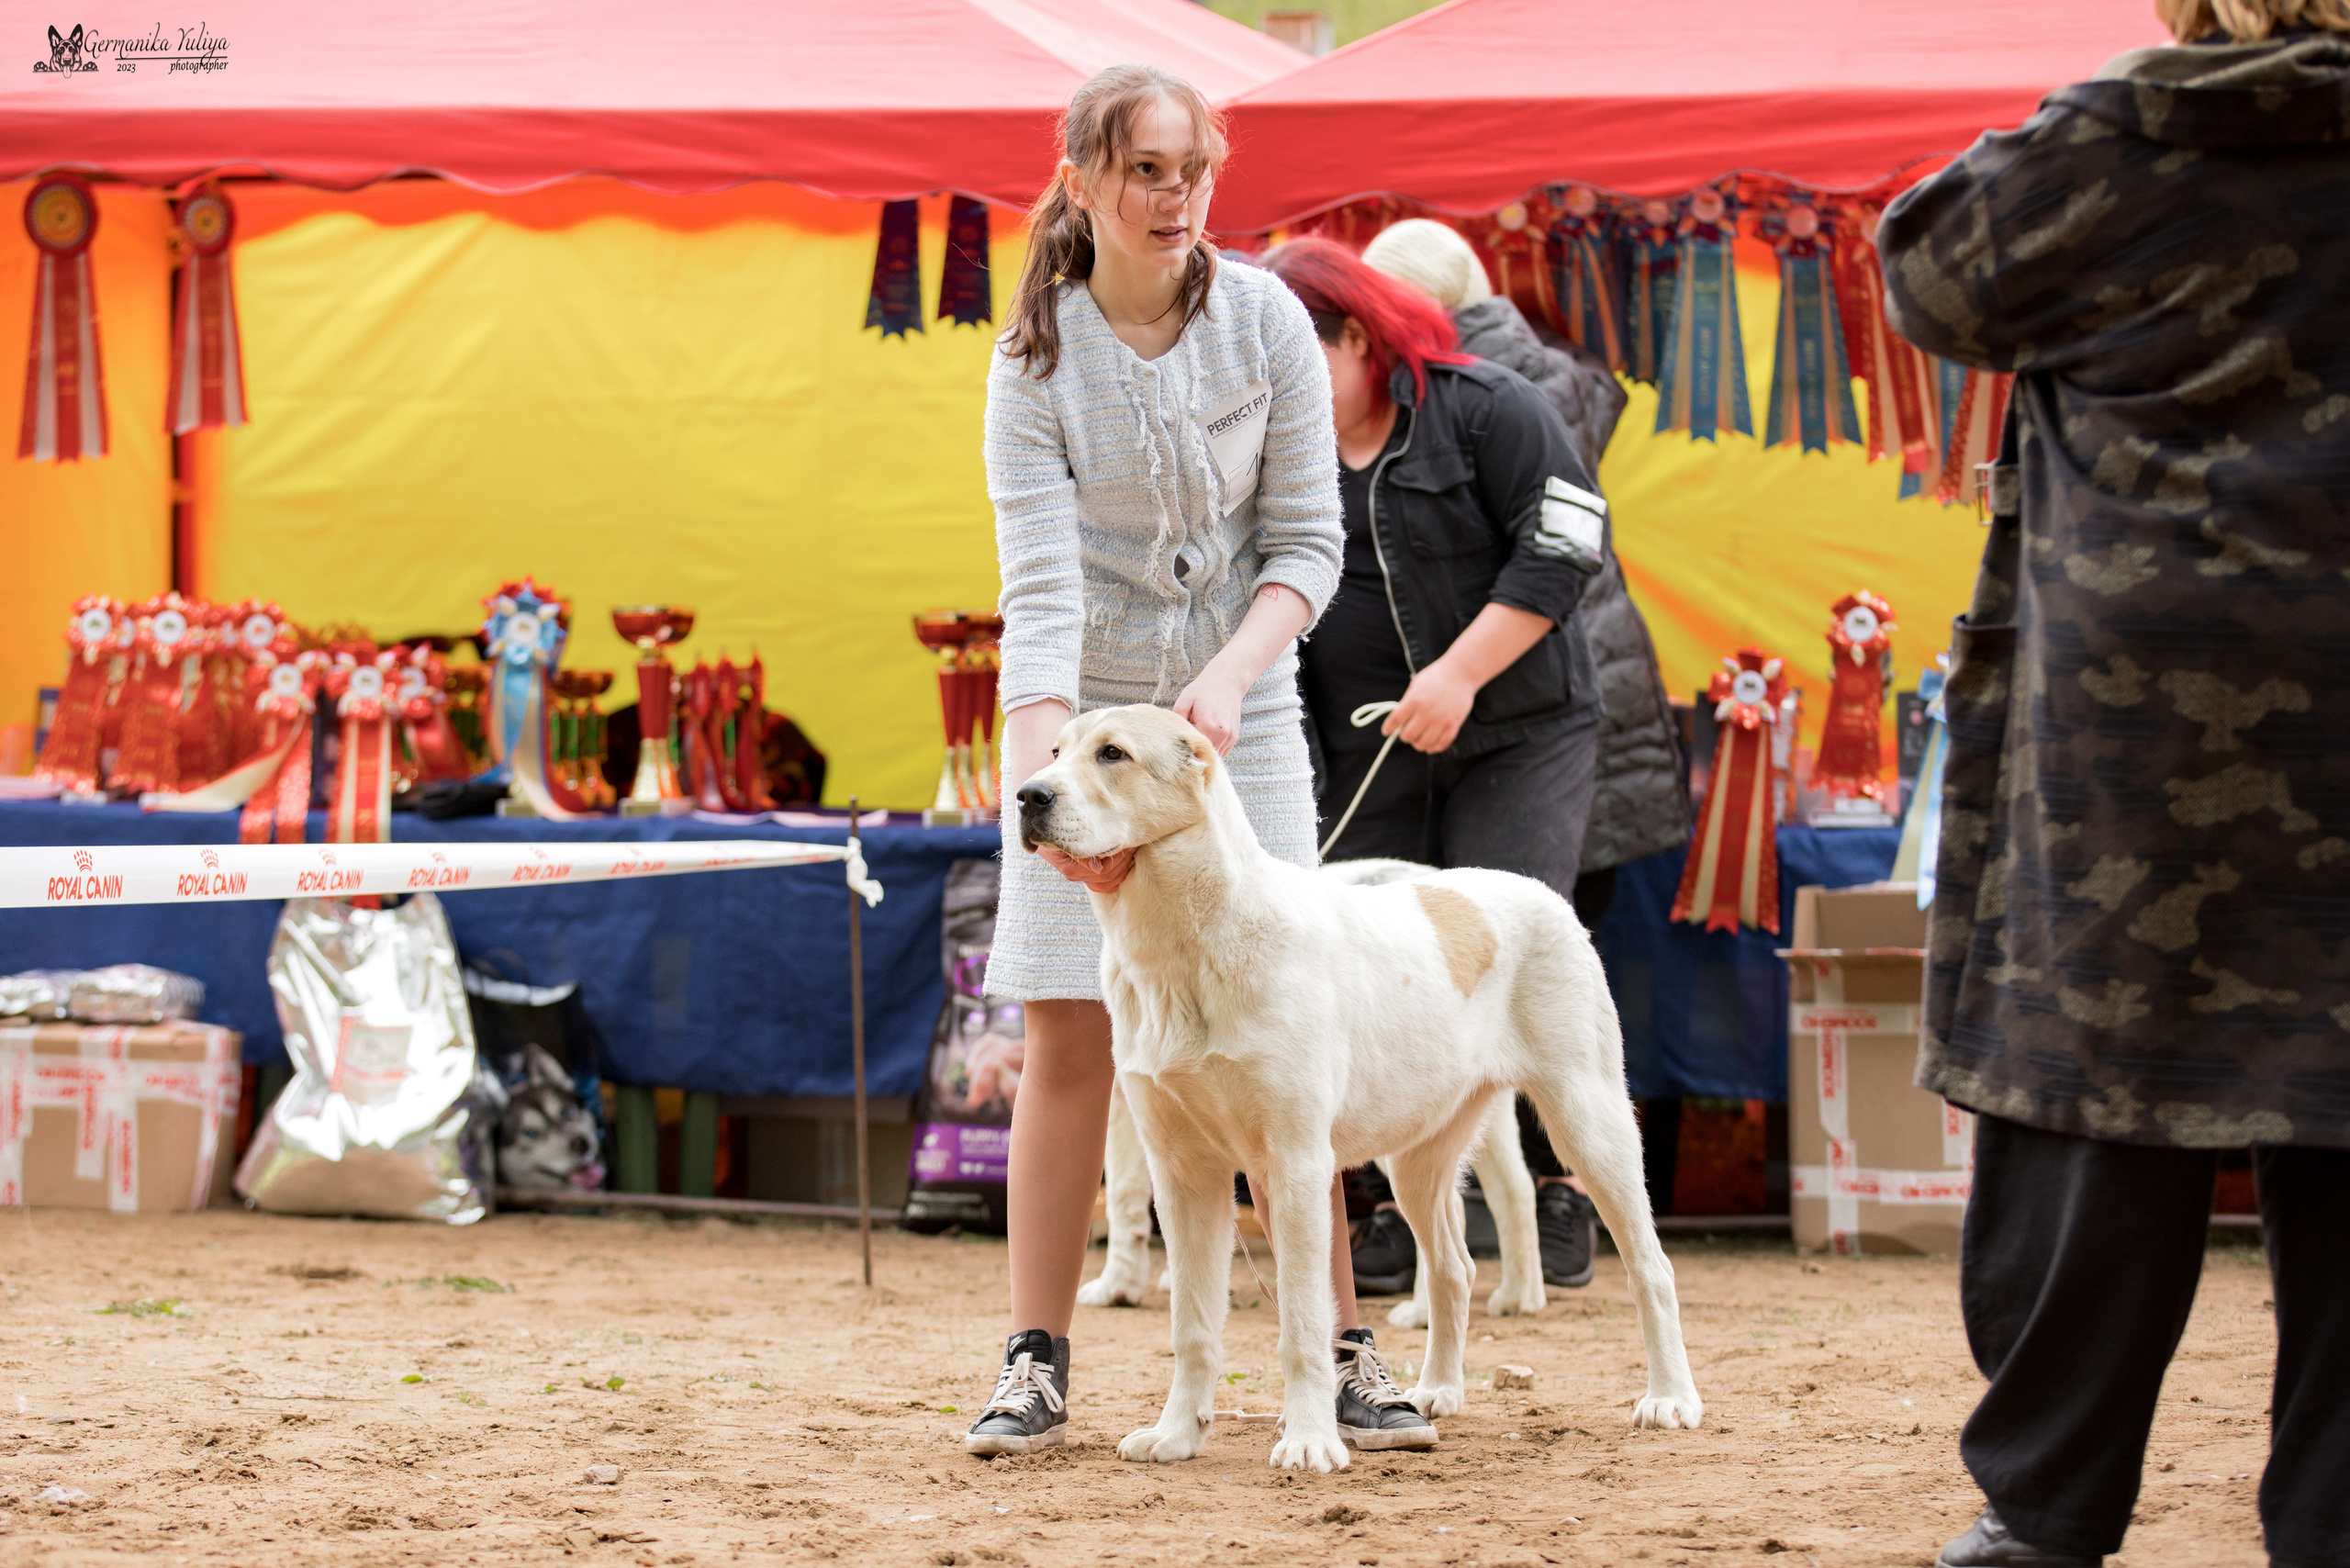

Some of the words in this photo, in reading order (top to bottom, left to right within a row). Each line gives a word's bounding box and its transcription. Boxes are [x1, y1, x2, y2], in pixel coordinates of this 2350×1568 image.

[1207, 402, 1252, 436] PERFECT
[1252, 392, 1268, 409] FIT
[48, 877, 84, 901] ROYAL
[86, 875, 123, 899] CANIN
[176, 873, 209, 896] ROYAL
[212, 872, 248, 895] CANIN
[297, 870, 329, 891] ROYAL
[330, 868, 364, 890] CANIN
[407, 867, 438, 888] ROYAL
[438, 865, 472, 885] CANIN
